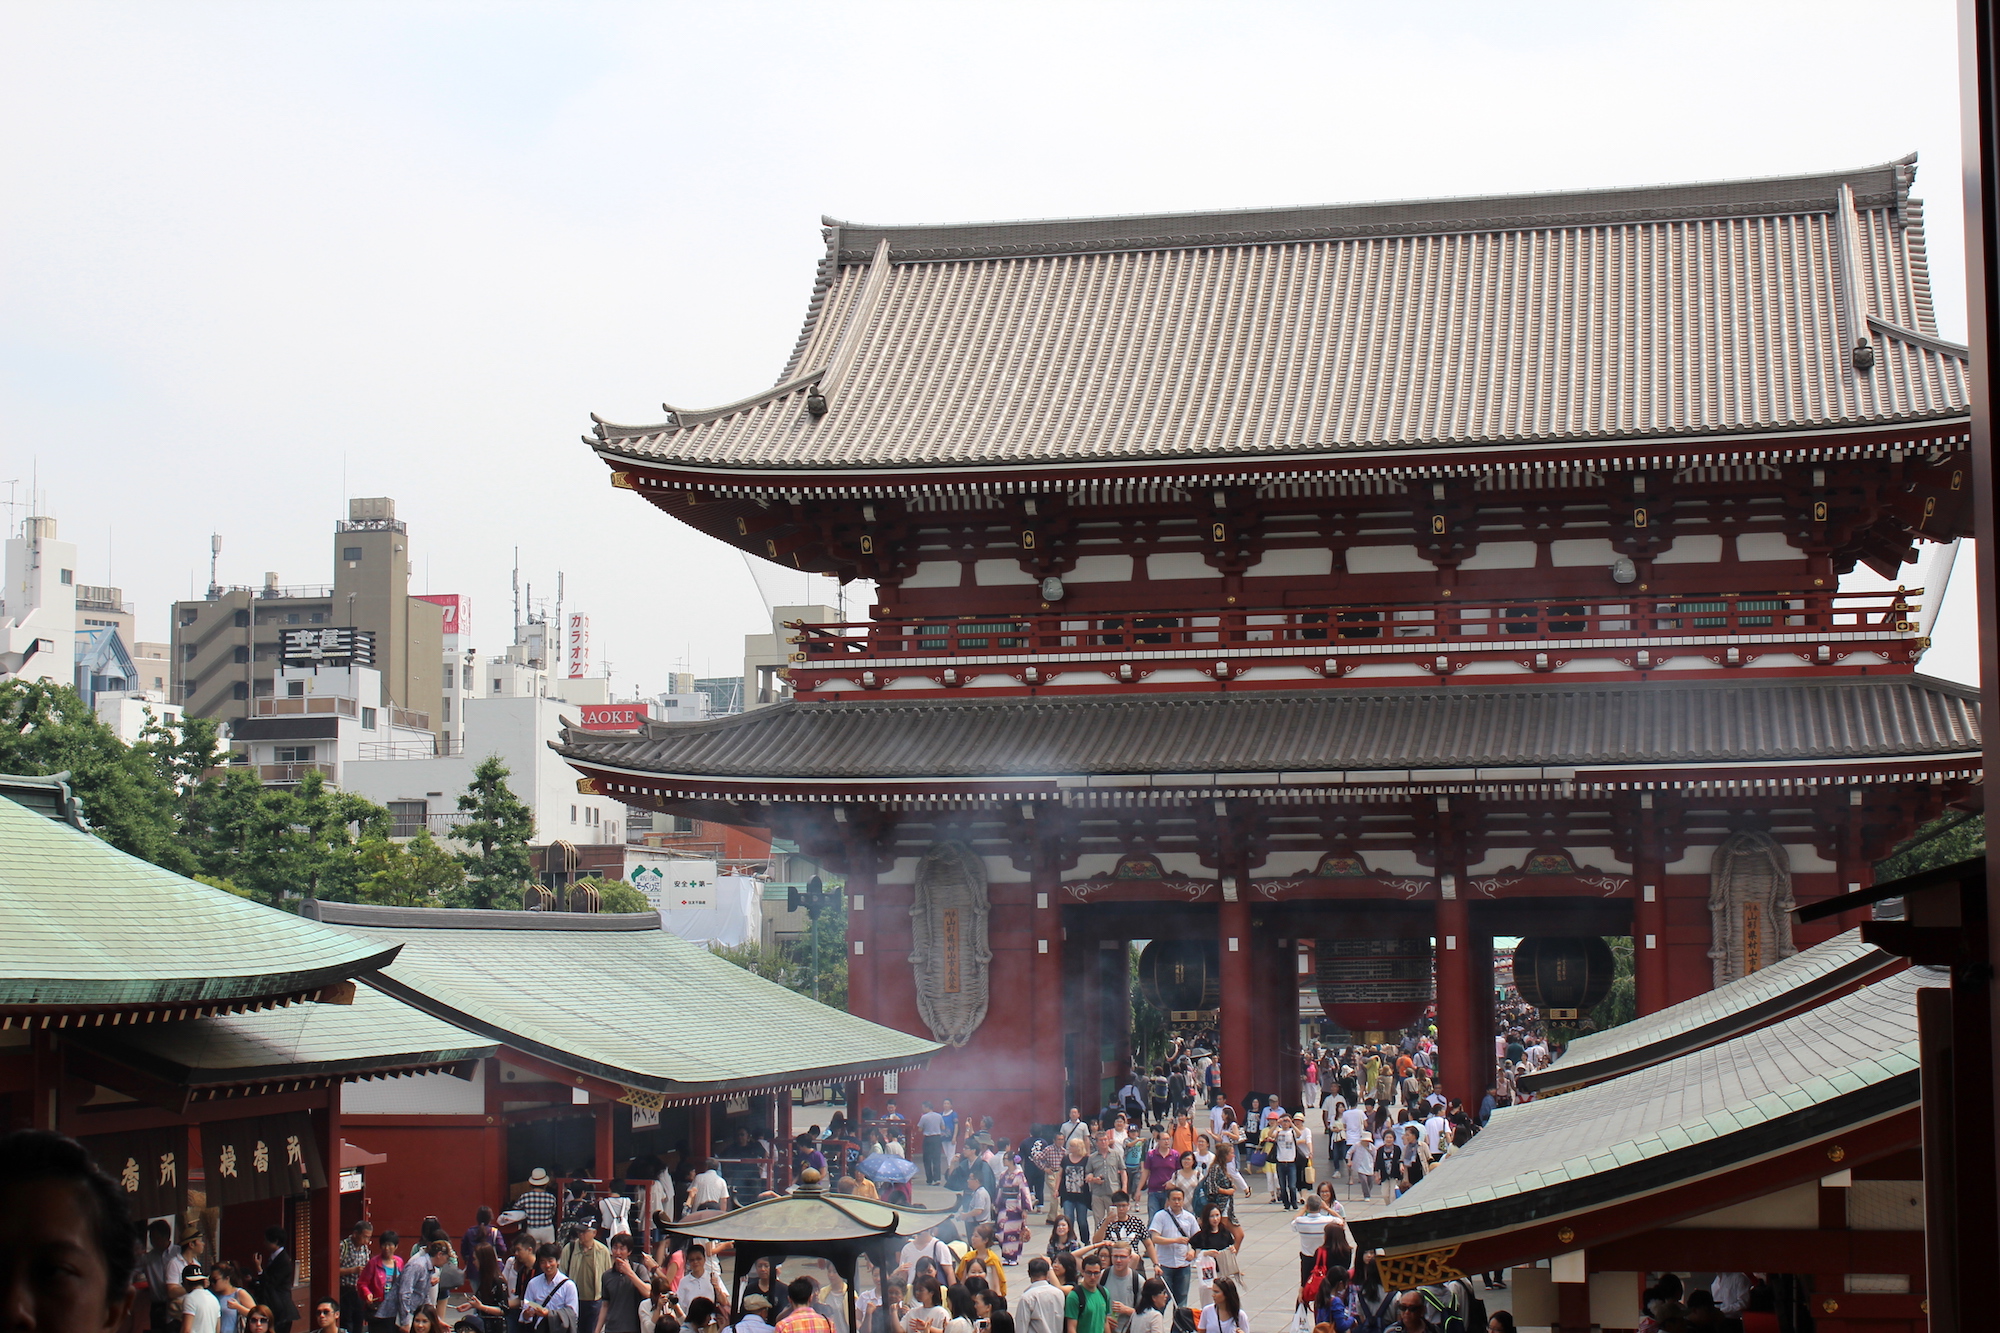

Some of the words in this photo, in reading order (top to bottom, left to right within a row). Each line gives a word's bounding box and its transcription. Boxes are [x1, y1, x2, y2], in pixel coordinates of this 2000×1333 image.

[294, 628, 340, 649] 中屋
[570, 615, 581, 674] カラオケ
[121, 1152, 177, 1193] 香所
[219, 1135, 302, 1178] 授香所
